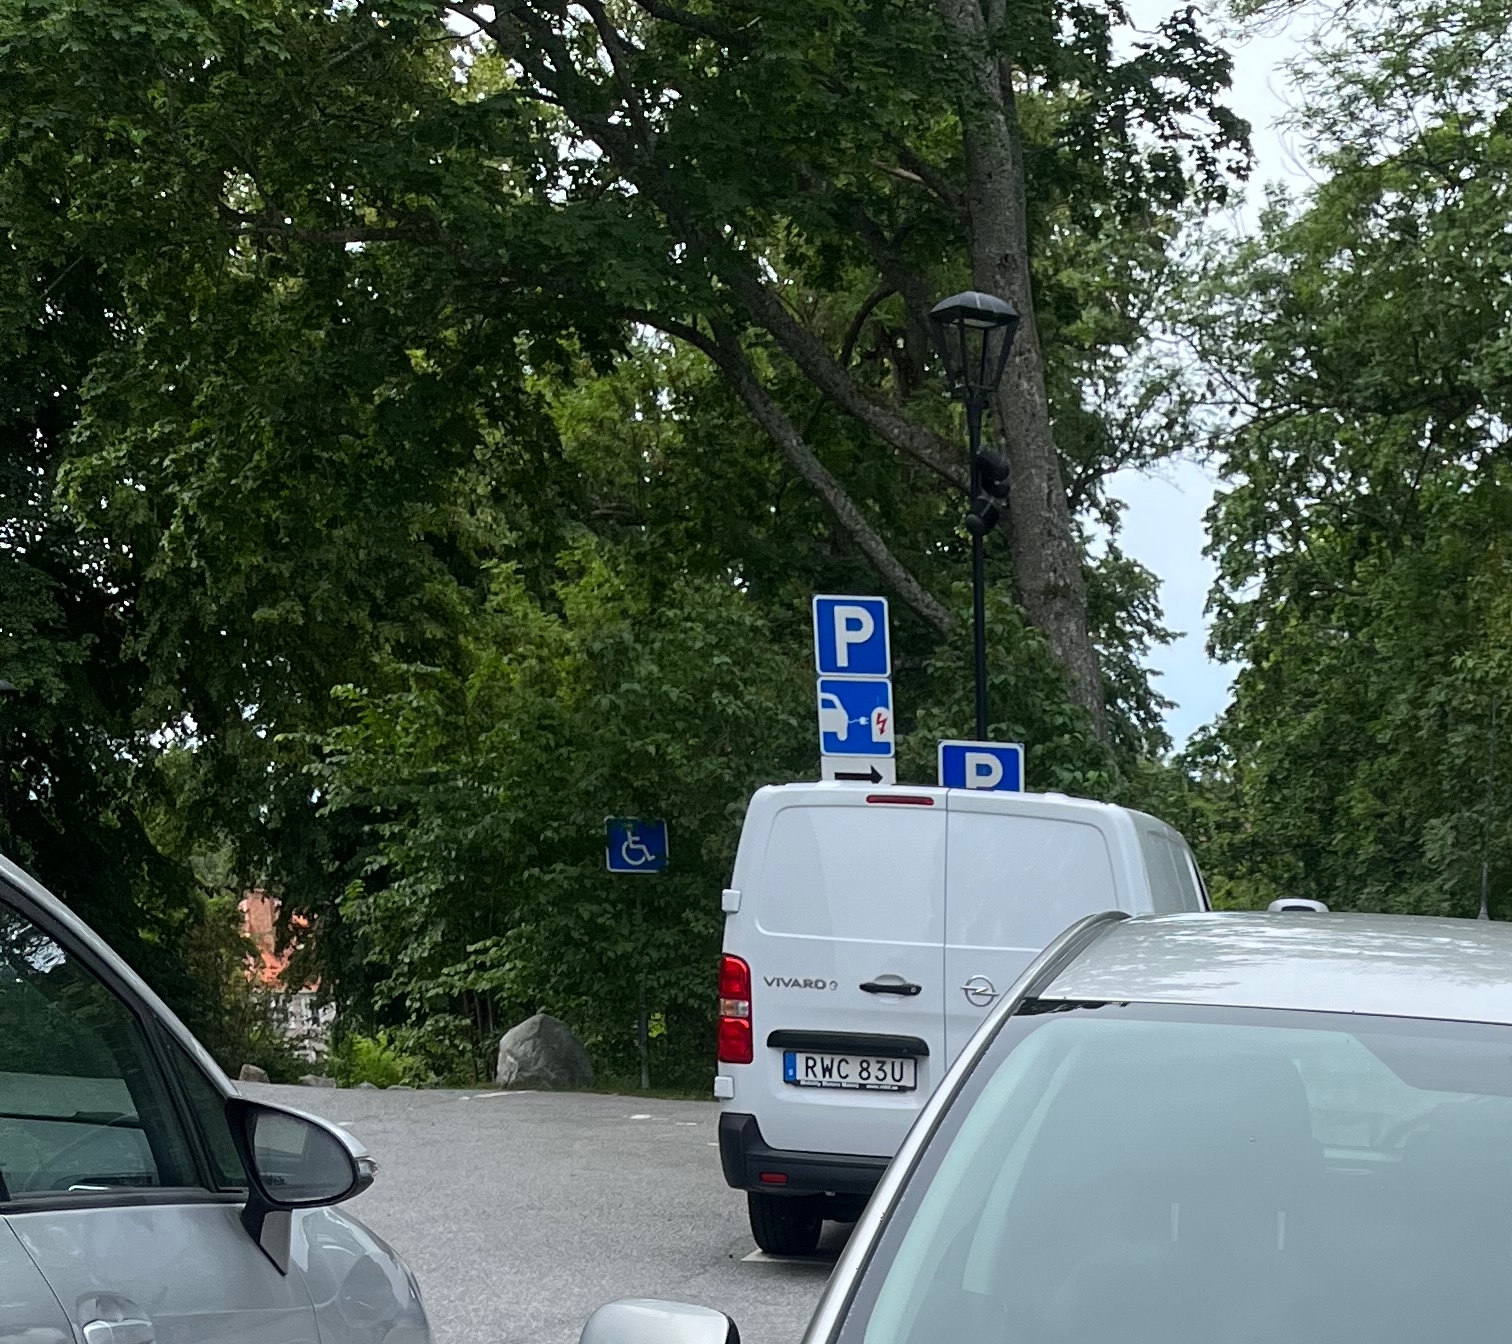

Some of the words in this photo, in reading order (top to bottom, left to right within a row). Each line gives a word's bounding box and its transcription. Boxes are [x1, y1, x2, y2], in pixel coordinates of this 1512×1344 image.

[834, 605, 875, 668] P
[965, 752, 1003, 789] P
[763, 976, 827, 990] VIVARO
[805, 1056, 850, 1079] RWC
[858, 1059, 904, 1083] 83U
